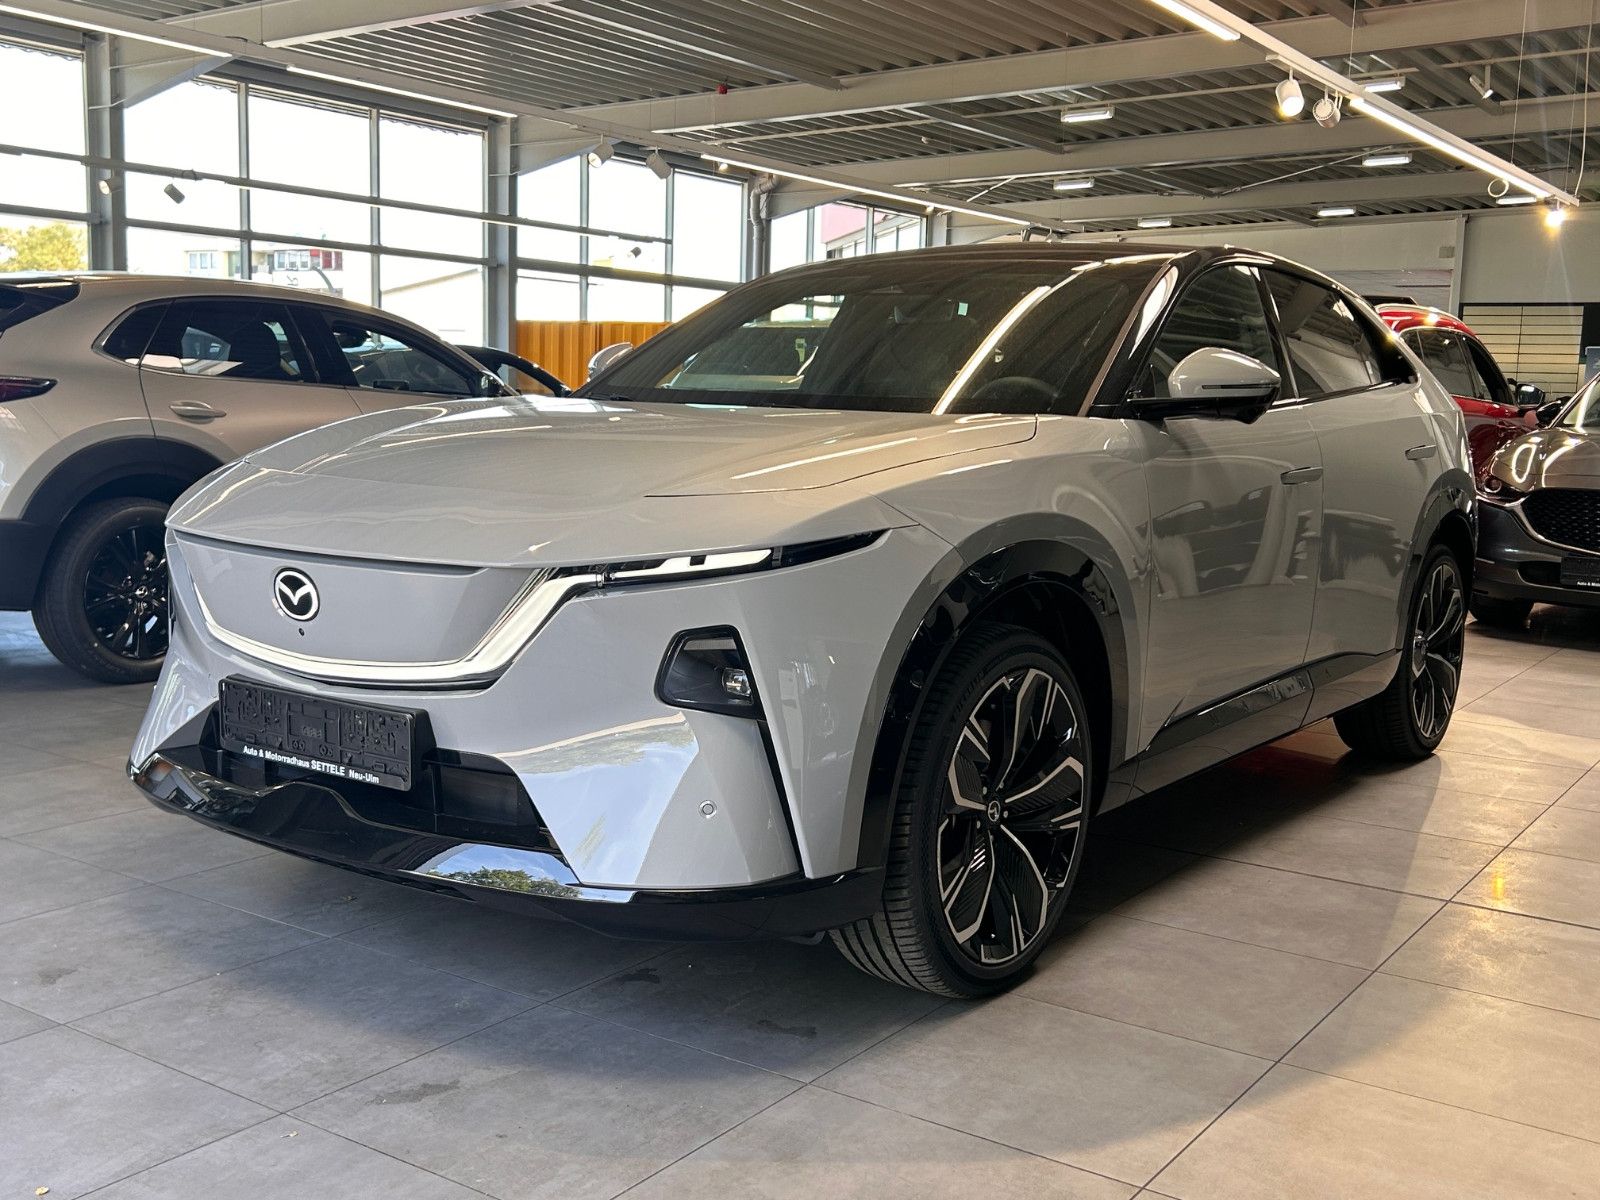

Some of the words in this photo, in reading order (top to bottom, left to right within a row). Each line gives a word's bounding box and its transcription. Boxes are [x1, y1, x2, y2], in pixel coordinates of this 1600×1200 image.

[243, 745, 258, 756] Auto
[258, 749, 264, 758] &
[265, 750, 310, 768] Motorradhaus
[311, 760, 345, 776] SETTELE
[349, 769, 379, 784] Neu-Ulm
